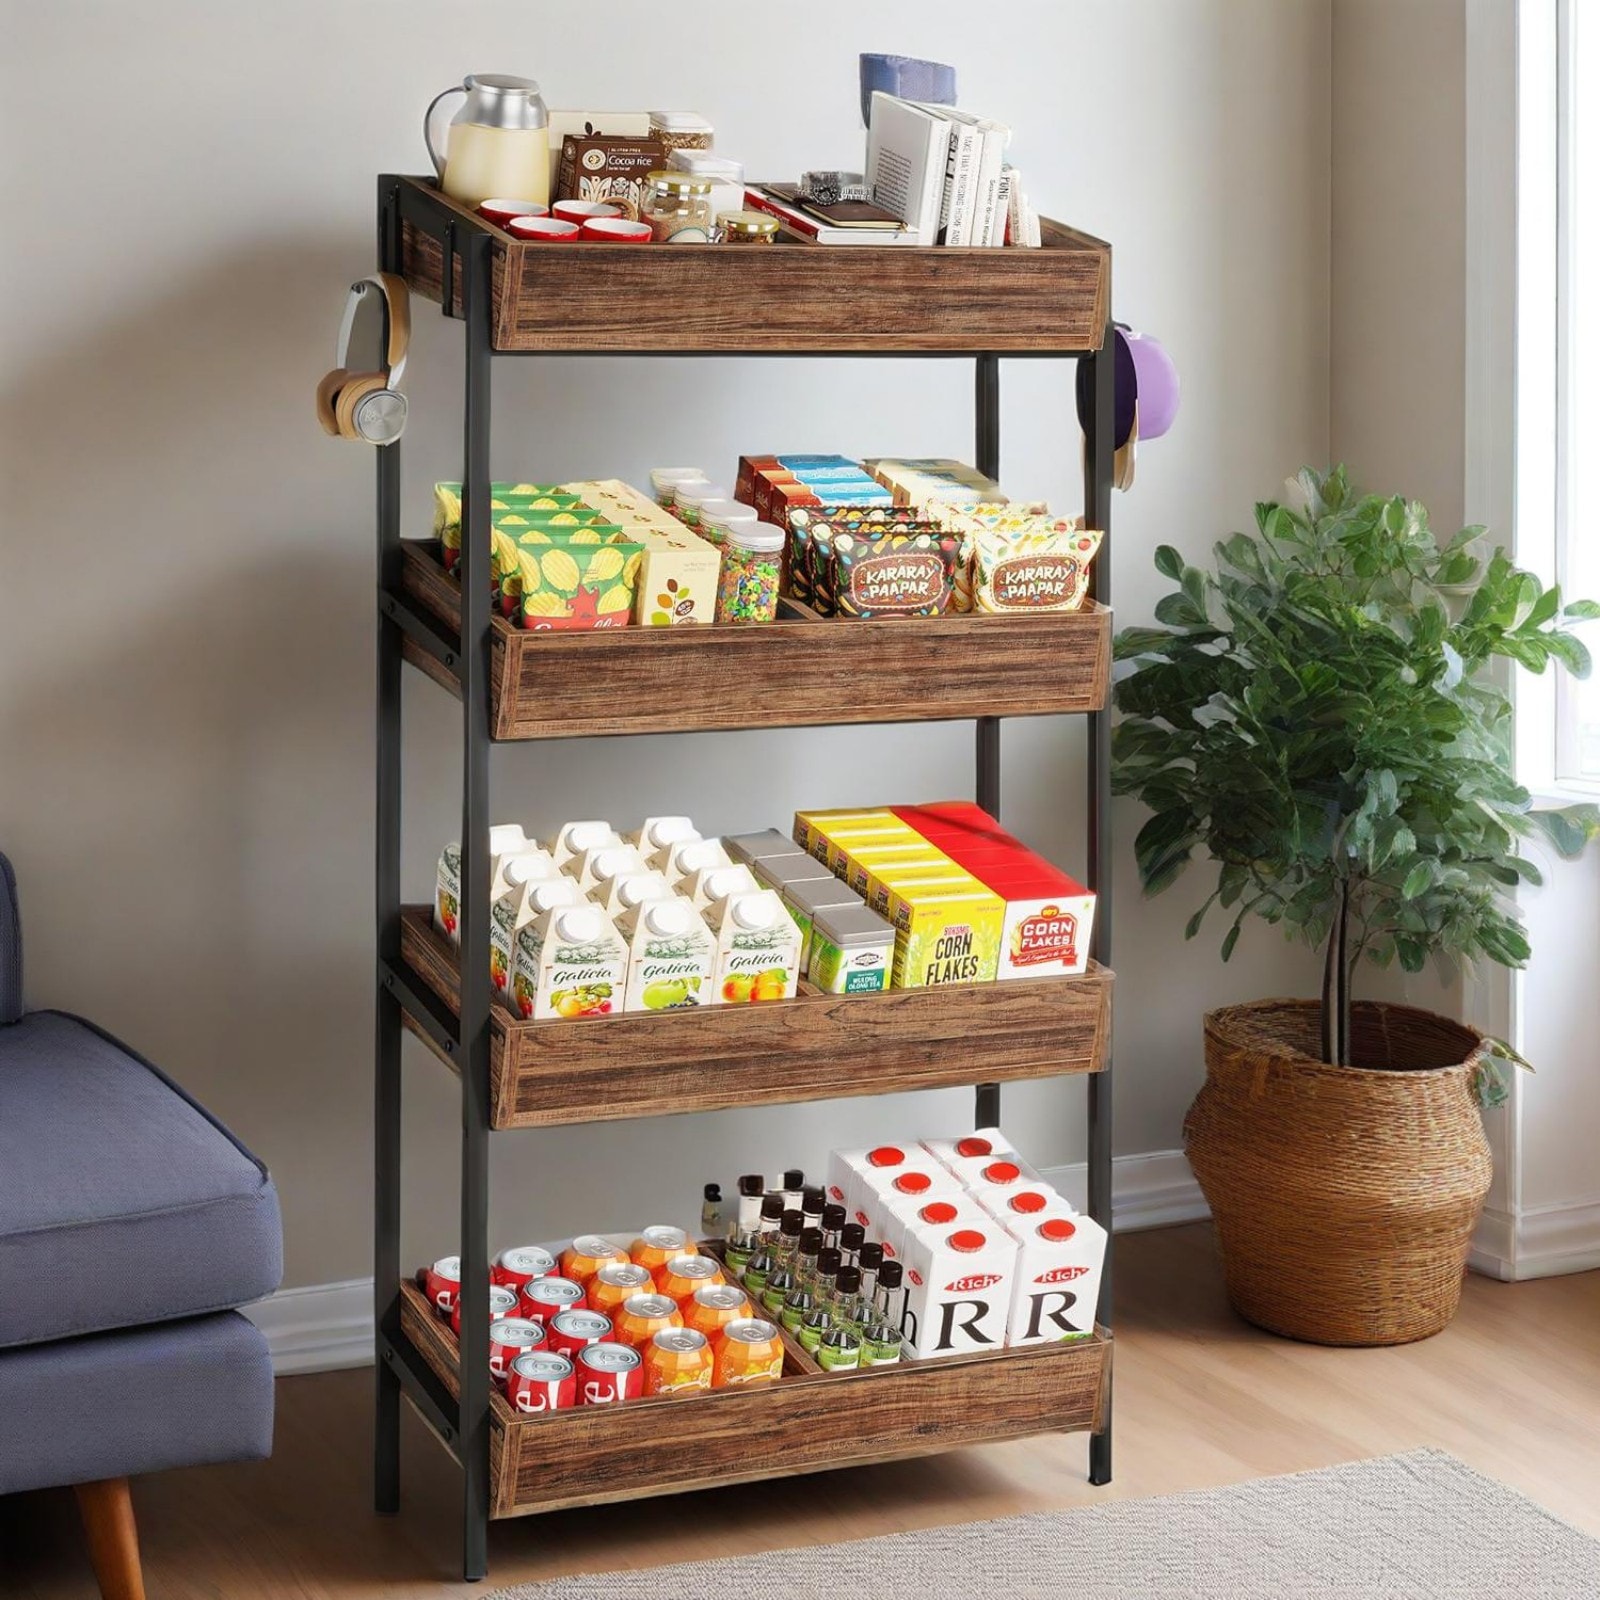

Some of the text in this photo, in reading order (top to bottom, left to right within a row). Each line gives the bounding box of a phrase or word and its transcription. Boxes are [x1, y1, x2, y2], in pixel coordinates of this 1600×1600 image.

[608, 155, 652, 166] Cocoa rice
[866, 565, 935, 584] KARARAY
[1005, 565, 1071, 585] KARARAY
[869, 581, 929, 598] PAAPAR
[1007, 581, 1065, 598] PAAPAR
[1023, 921, 1072, 936] CORN
[935, 933, 973, 960] CORN
[1021, 936, 1070, 950] FLAKES
[643, 961, 701, 978] Galicia
[730, 953, 784, 969] Galicia
[553, 968, 612, 985] Galicia
[926, 955, 978, 985] FLAKES
[1022, 1291, 1083, 1340] R
[933, 1300, 995, 1350] R
